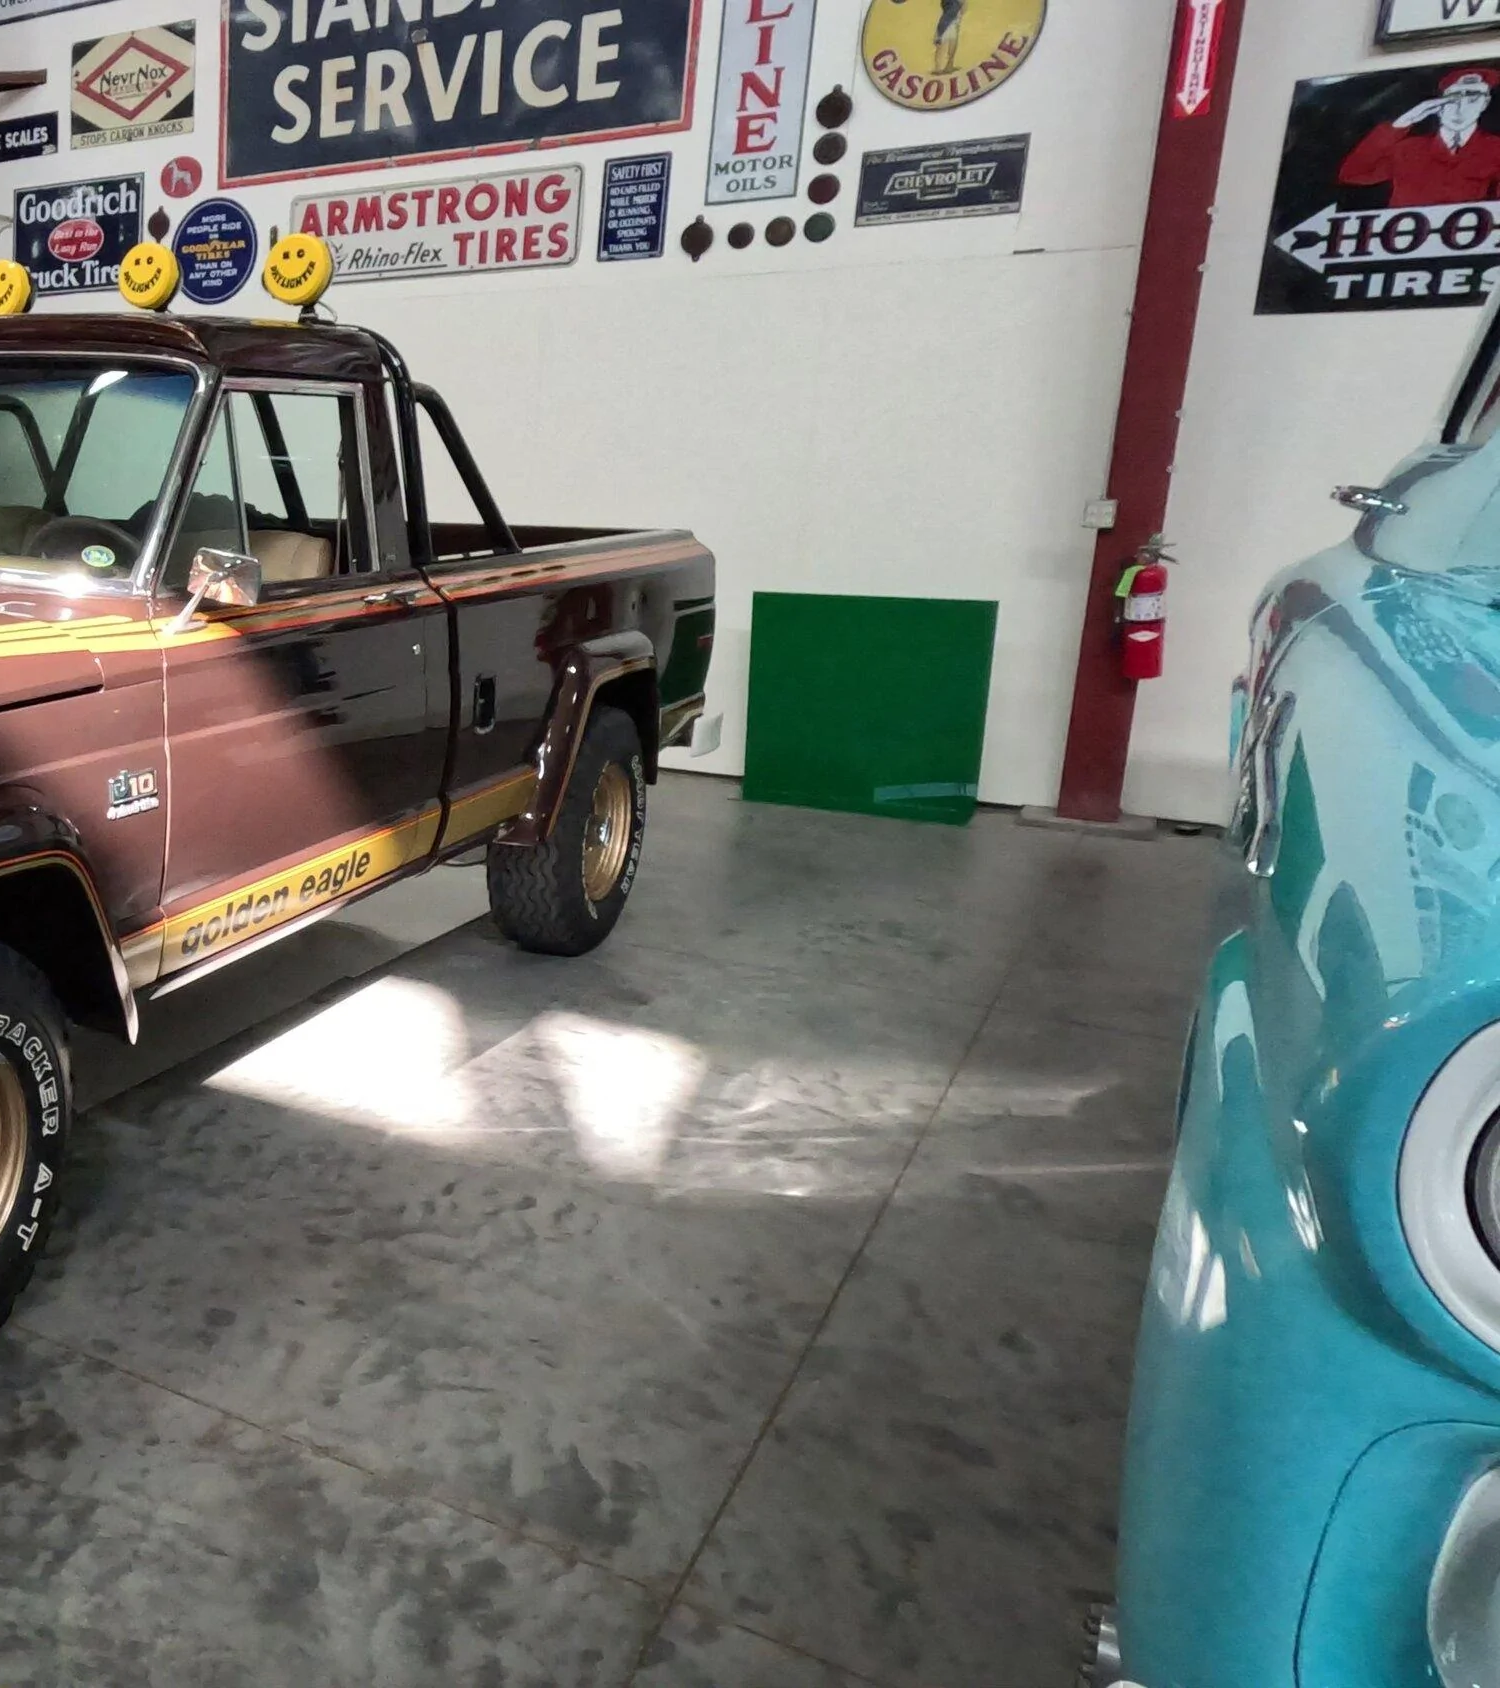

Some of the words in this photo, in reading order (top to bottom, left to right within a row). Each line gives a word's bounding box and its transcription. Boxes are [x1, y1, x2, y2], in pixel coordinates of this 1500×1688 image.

[271, 10, 624, 144] SERVICE
[872, 32, 1029, 103] GASOLINE
[5, 126, 49, 149] SCALES
[80, 131, 107, 147] STOPS
[110, 125, 145, 142] CARBON
[148, 120, 184, 136] KNOCKS
[611, 164, 641, 181] SAFETY
[641, 161, 663, 178] FIRST
[714, 154, 794, 176] MOTOR
[639, 182, 661, 193] FILLED
[725, 174, 777, 193] OILS
[894, 168, 987, 190] CHEVROLET
[19, 182, 138, 225] Goodrich
[300, 174, 572, 237] ARMSTRONG
[186, 223, 219, 234] PEOPLE
[221, 221, 242, 231] RIDE
[201, 213, 227, 223] MORE
[1319, 206, 1500, 259] HOO
[181, 239, 246, 254] GOODYEAR
[453, 222, 570, 266] TIRES
[609, 243, 633, 253] THANK
[635, 241, 650, 251] YOU
[194, 261, 219, 271] THAN
[220, 260, 233, 269] ON
[196, 250, 231, 261] TIRES
[348, 241, 443, 271] Rhino-Flex
[123, 267, 163, 293] DAYLIGHTER
[188, 271, 207, 280] ANY
[209, 267, 239, 278] OTHER
[201, 278, 224, 288] KIND
[269, 260, 317, 289] DAYLIGHTER
[1326, 266, 1496, 300] TIRES
[180, 885, 289, 957] golden
[299, 850, 371, 902] eagle
